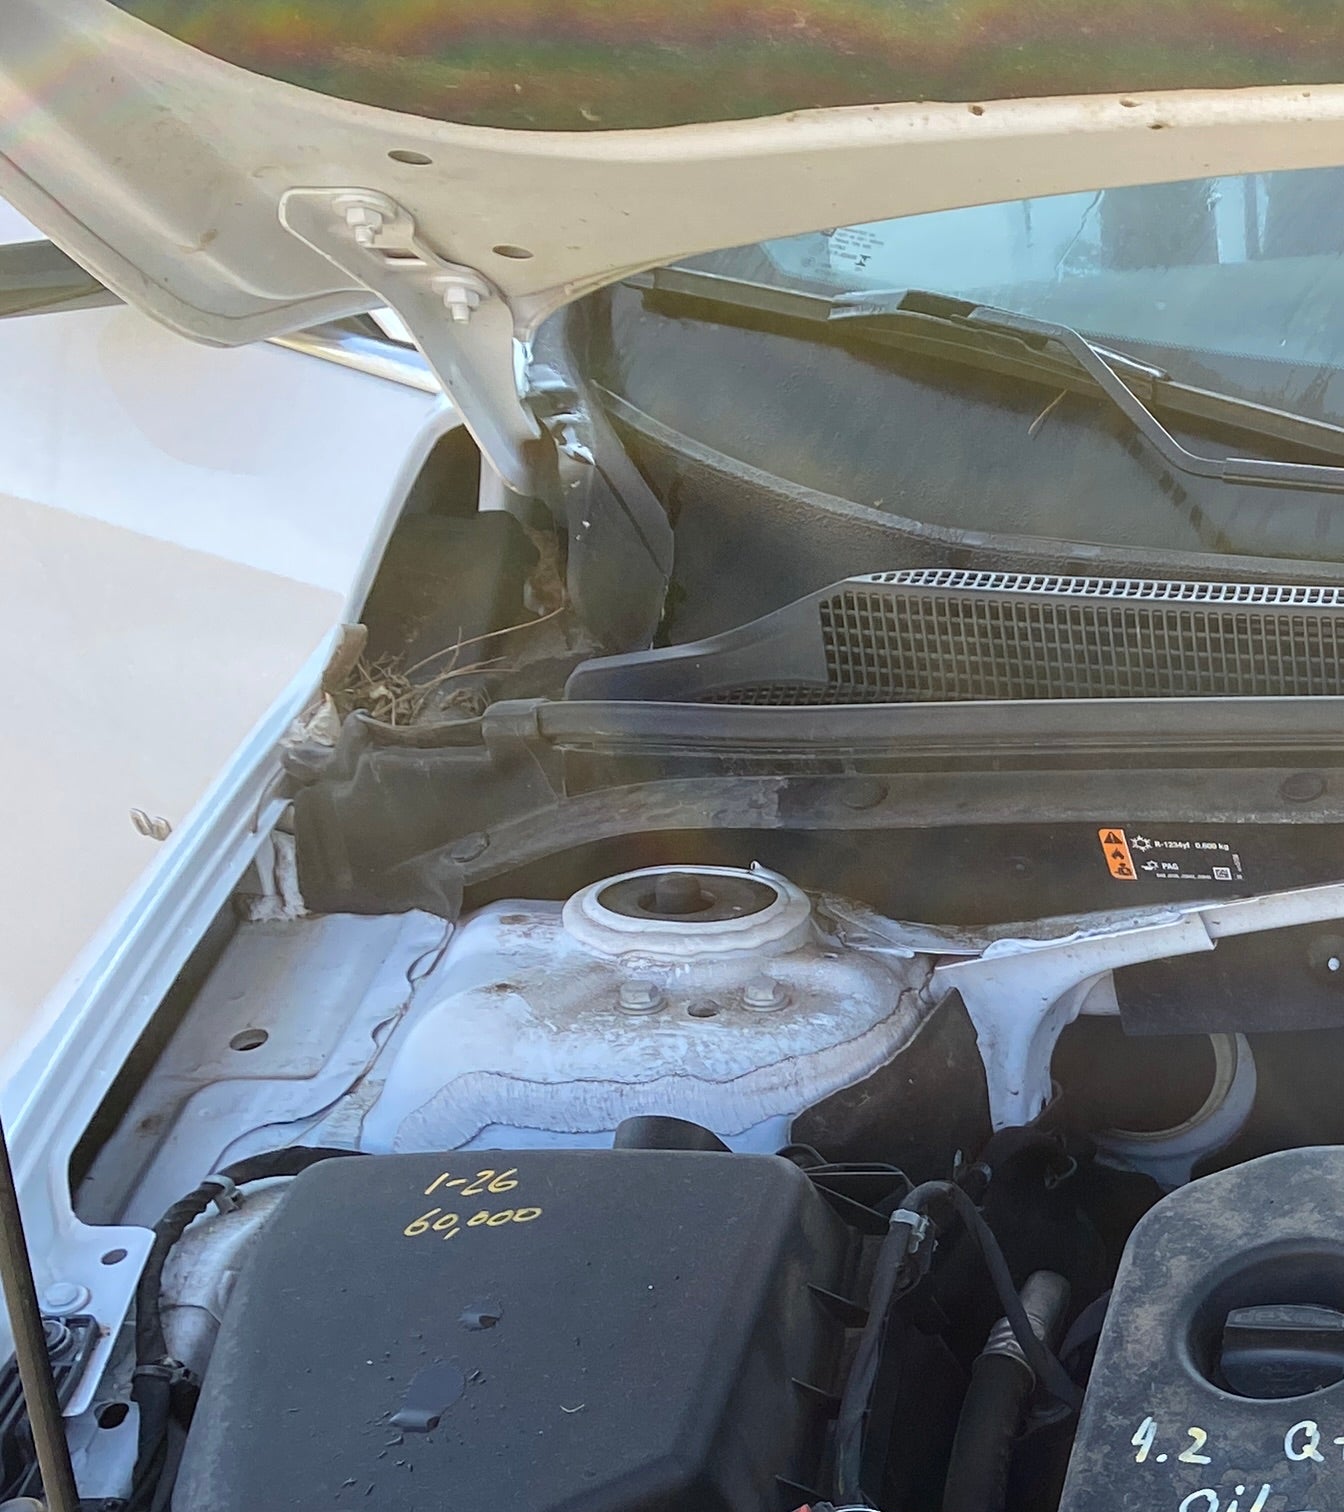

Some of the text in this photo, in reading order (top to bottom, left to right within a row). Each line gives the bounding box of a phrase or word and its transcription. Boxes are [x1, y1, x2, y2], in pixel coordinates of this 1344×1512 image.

[1161, 862, 1179, 870] PAG
[423, 1167, 519, 1197] 1-26
[403, 1206, 544, 1241] 60,000
[1130, 1416, 1212, 1464] 4.2
